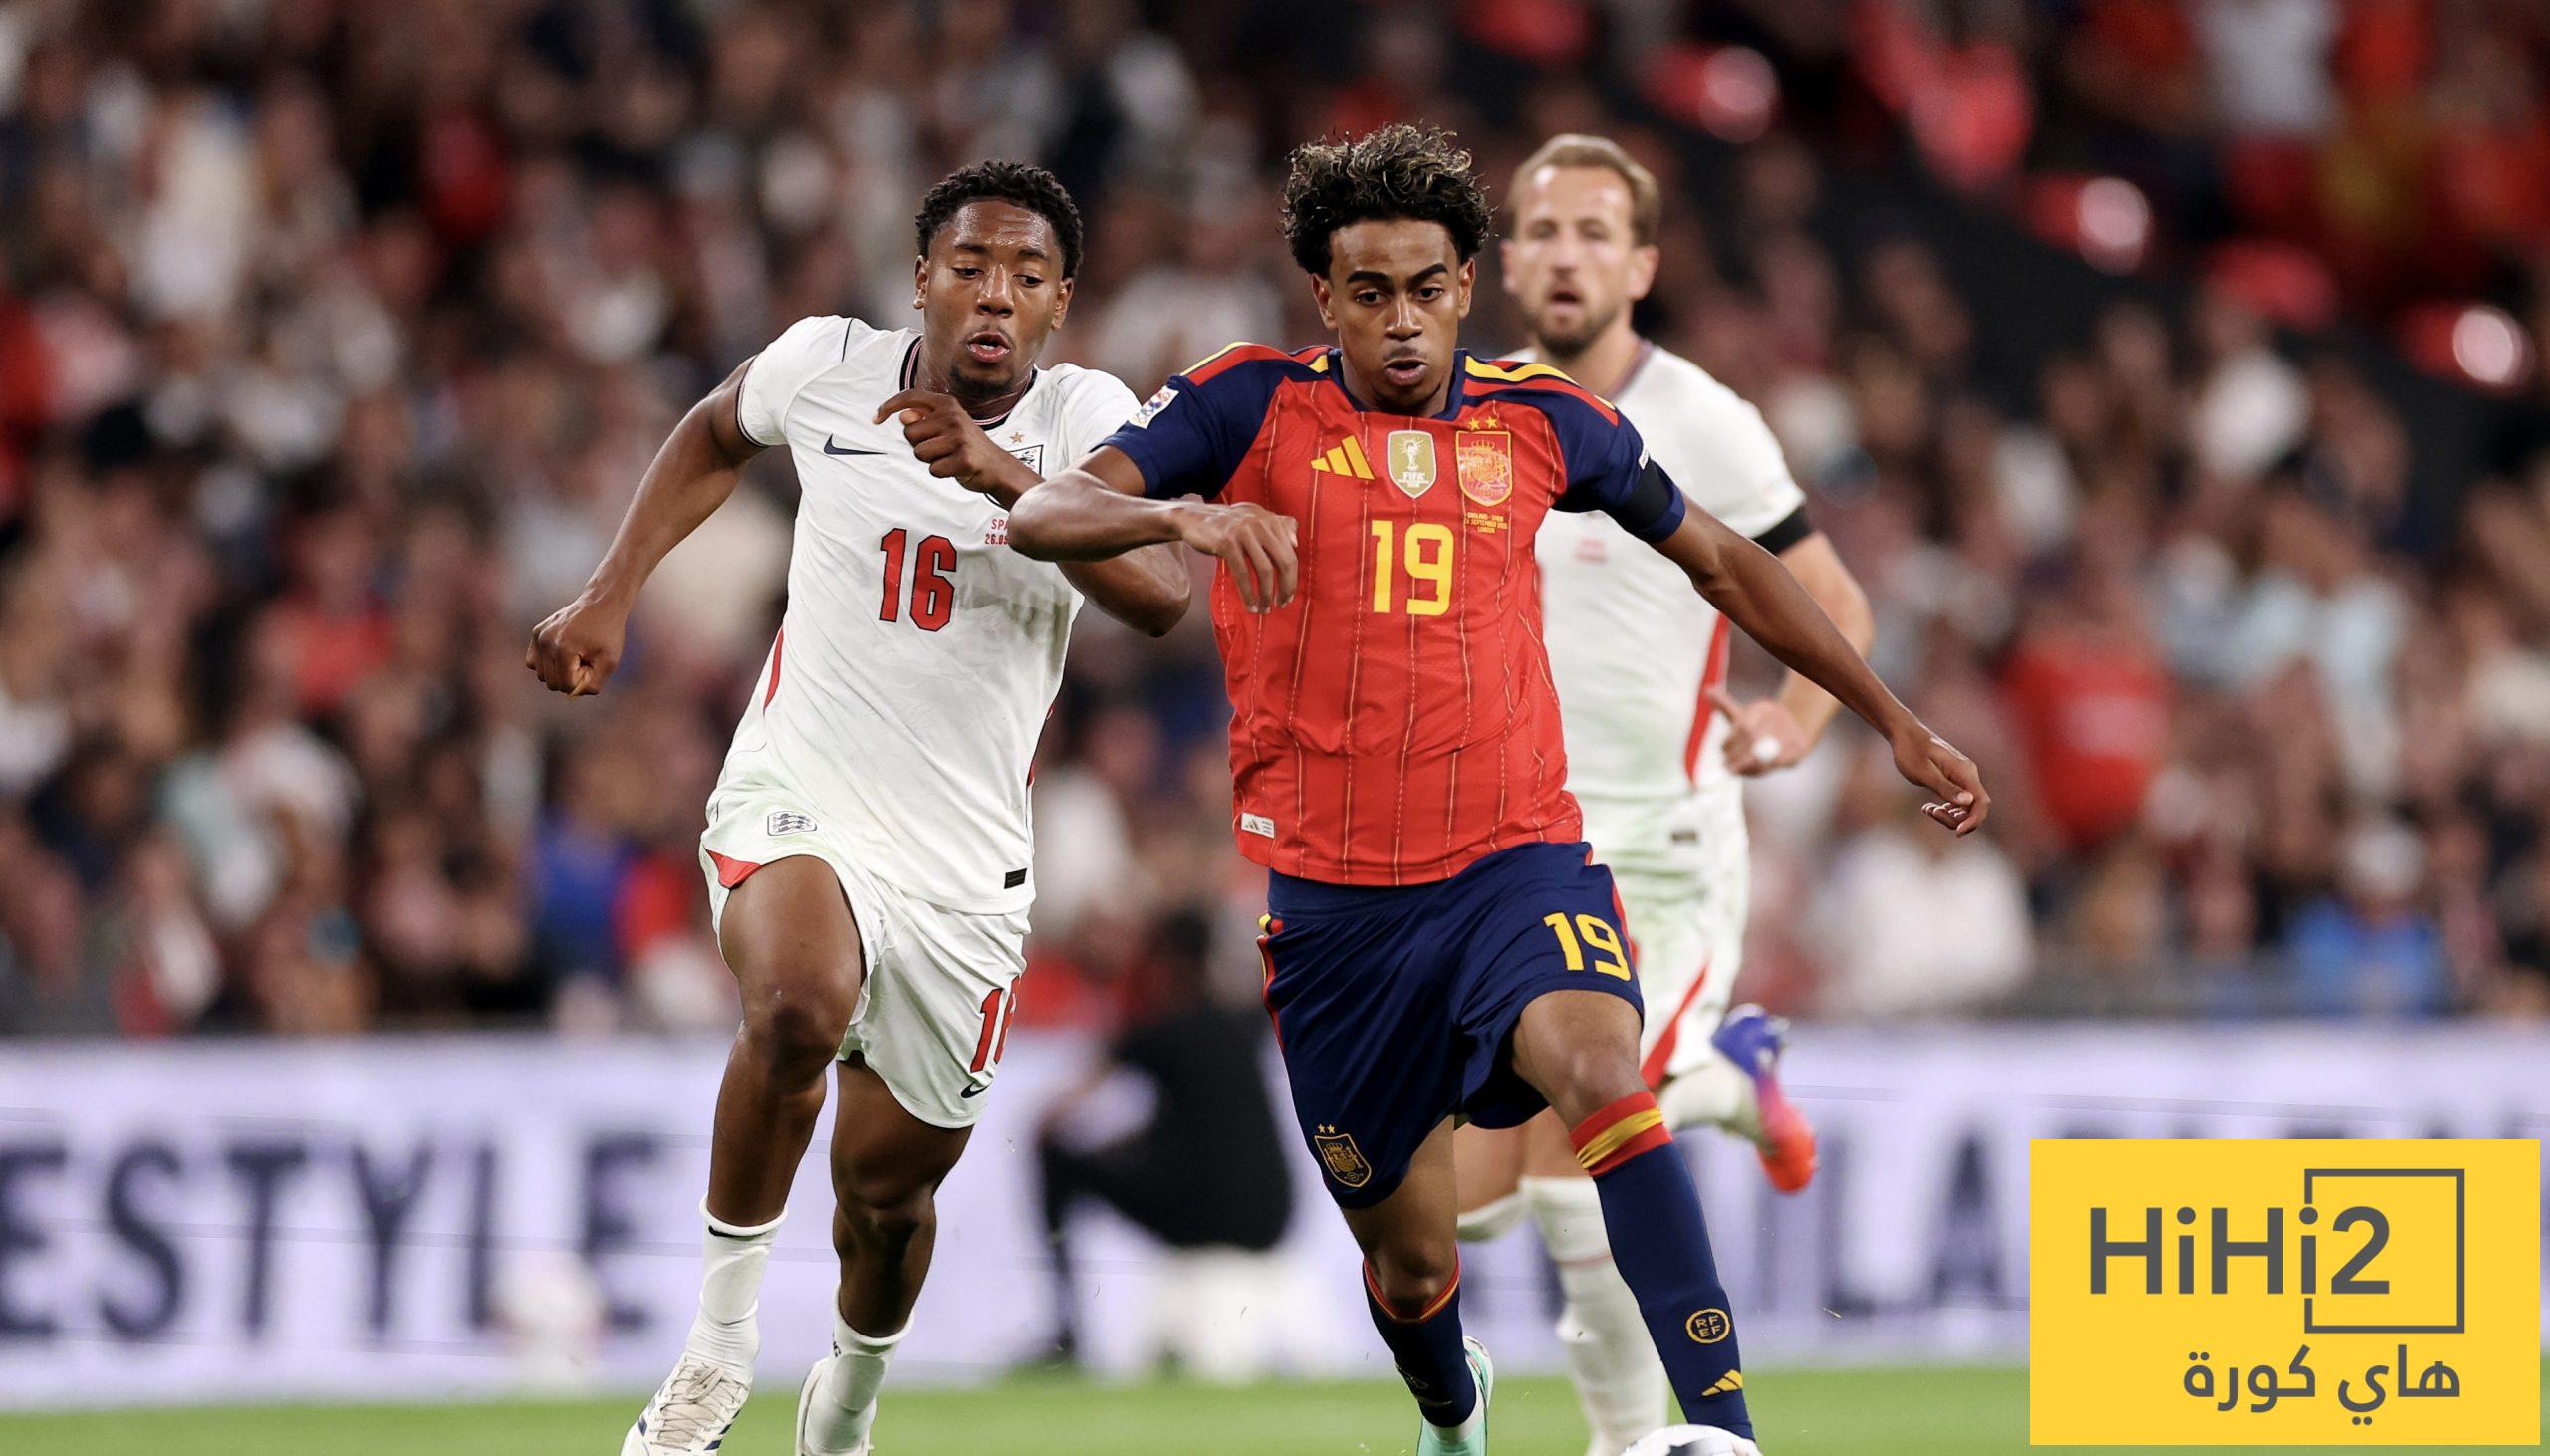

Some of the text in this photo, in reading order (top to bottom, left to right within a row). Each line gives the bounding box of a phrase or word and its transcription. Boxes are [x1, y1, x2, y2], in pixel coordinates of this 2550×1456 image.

[879, 528, 957, 632] 16
[1372, 519, 1454, 616] 19
[1544, 911, 1632, 982] 19
